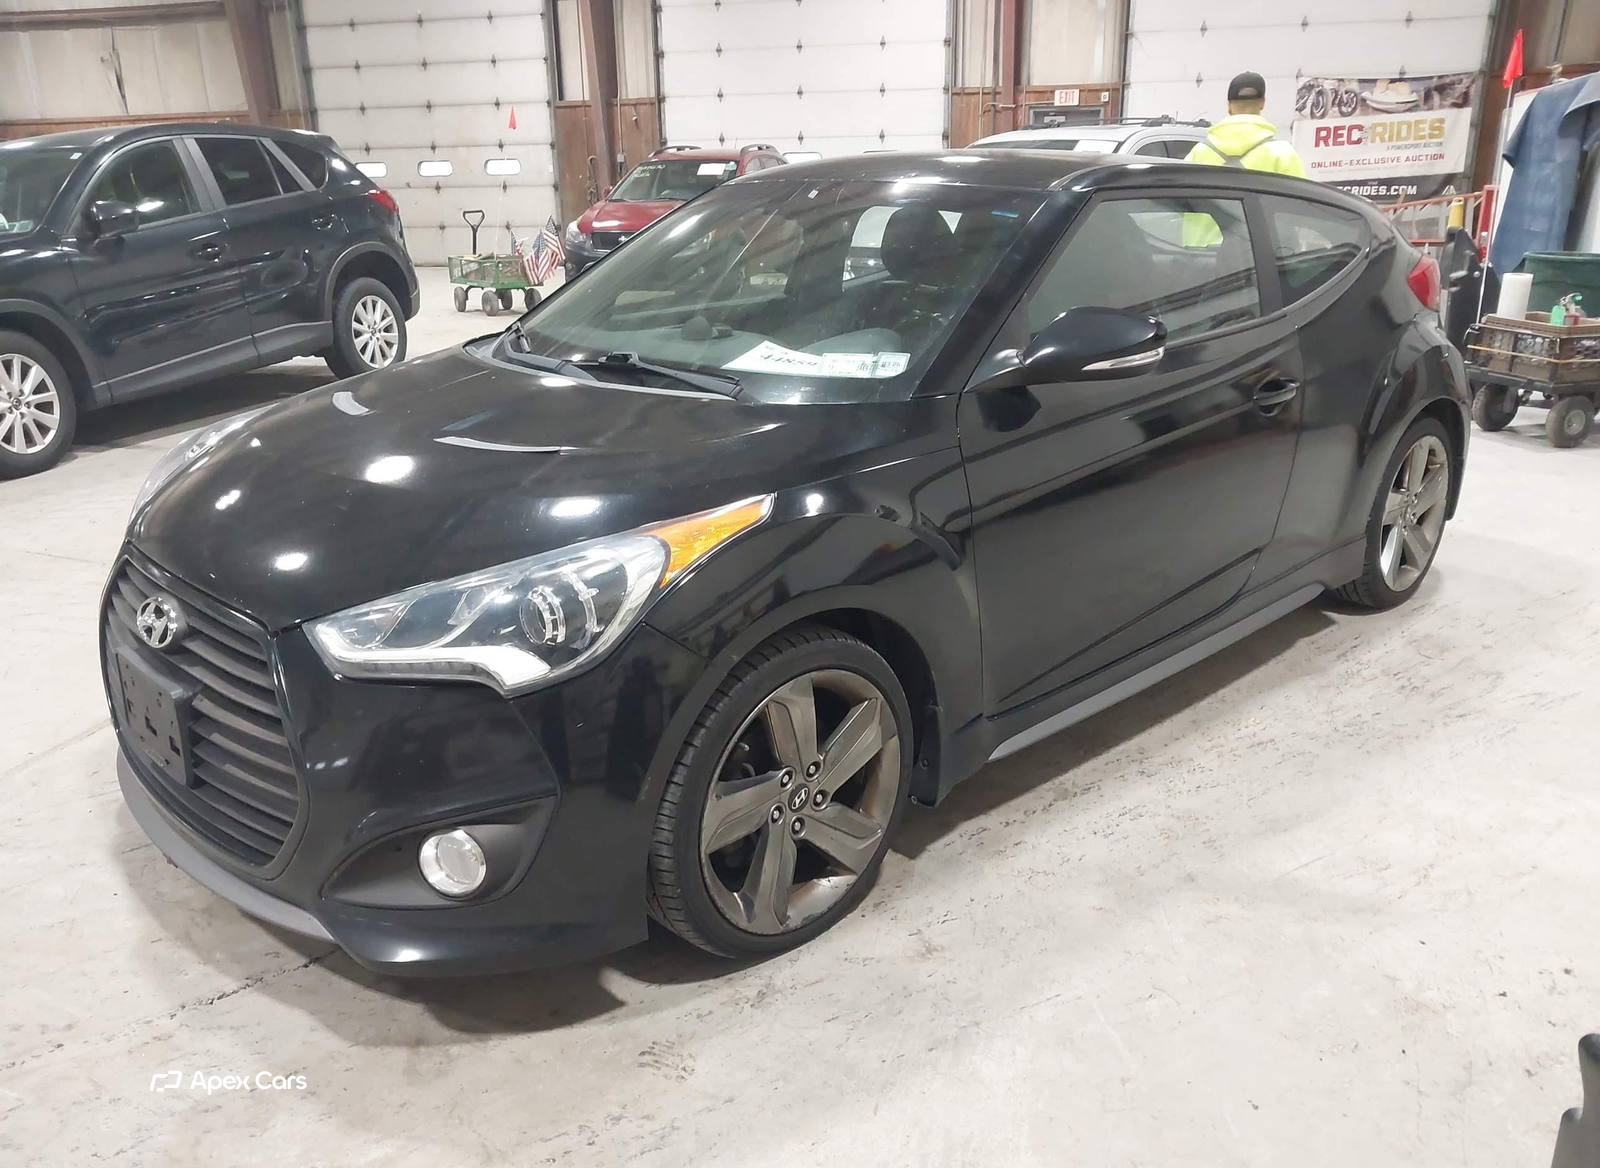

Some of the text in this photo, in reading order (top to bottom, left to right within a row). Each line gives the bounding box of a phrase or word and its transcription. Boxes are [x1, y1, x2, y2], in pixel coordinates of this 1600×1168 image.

[1060, 91, 1075, 104] EXIT
[1314, 118, 1445, 147] REC RIDES
[1423, 141, 1443, 149] AUCTION
[1311, 156, 1401, 168] ONLINE-EXCLUSIVE
[1405, 154, 1445, 162] AUCTION
